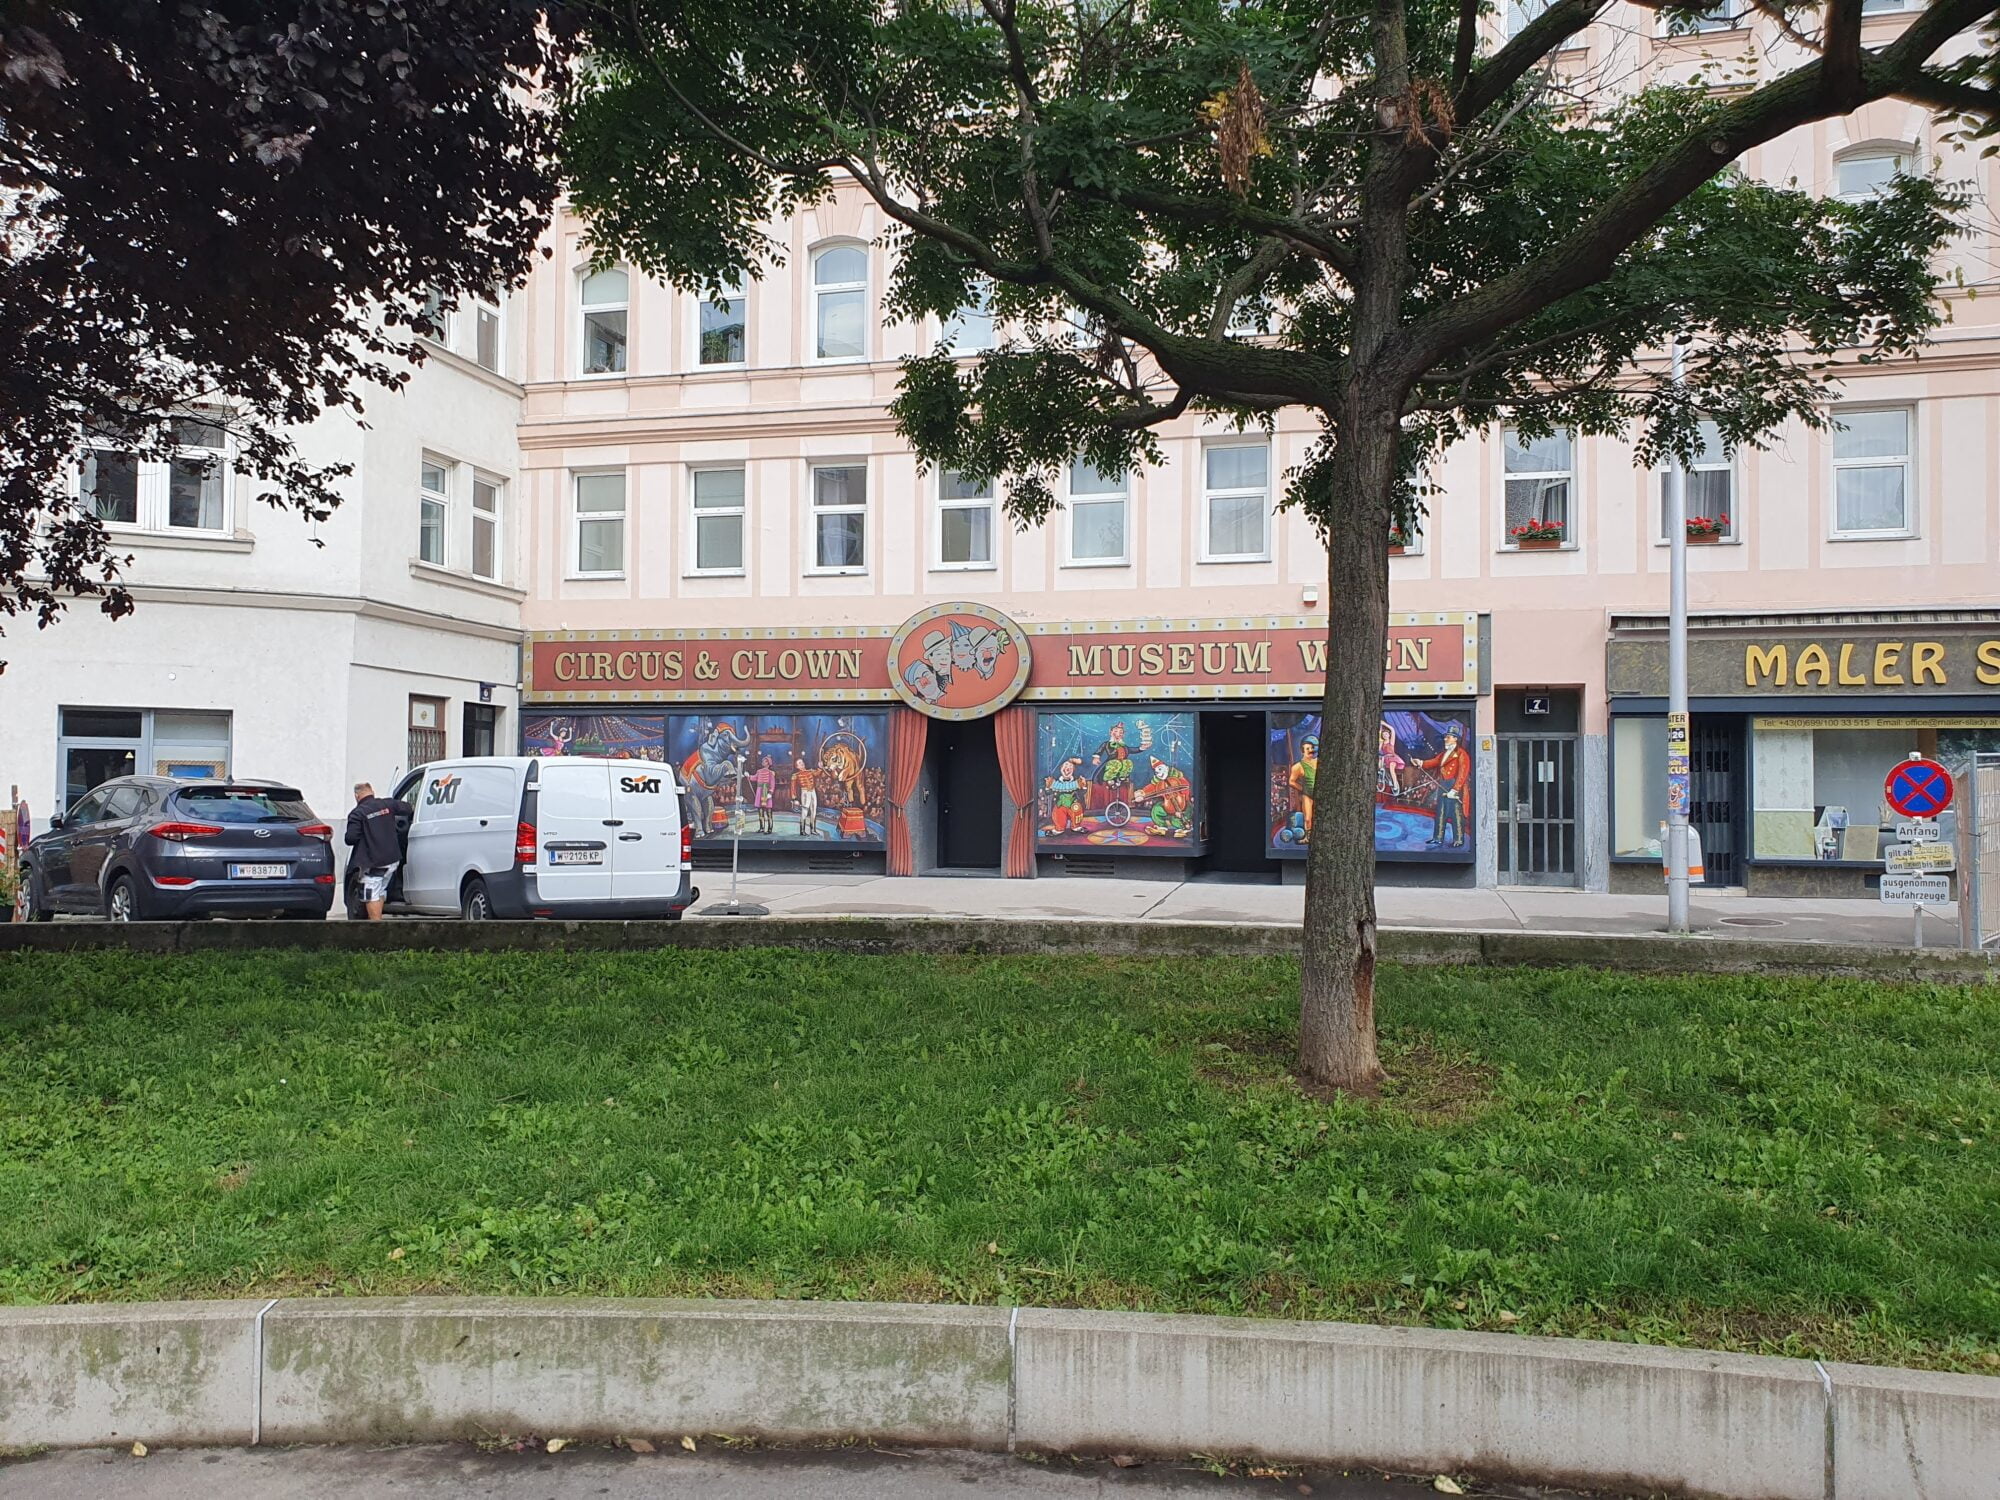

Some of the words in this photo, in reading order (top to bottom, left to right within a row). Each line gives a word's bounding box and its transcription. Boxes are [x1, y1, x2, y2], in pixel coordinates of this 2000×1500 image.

[1068, 641, 1272, 676] MUSEUM
[1297, 638, 1432, 672] WN
[554, 650, 684, 681] CIRCUS
[694, 650, 720, 680] &
[731, 649, 863, 680] CLOWN
[1745, 642, 1947, 686] MALER
[1533, 699, 1542, 710] 7
[1672, 730, 1685, 739] 26
[1899, 826, 1938, 838] Anfang
[1888, 850, 1900, 858] gilt
[1921, 861, 1933, 869] bis
[1883, 879, 1947, 889] ausgenommen
[1885, 891, 1946, 902] Baufahrzeuge
